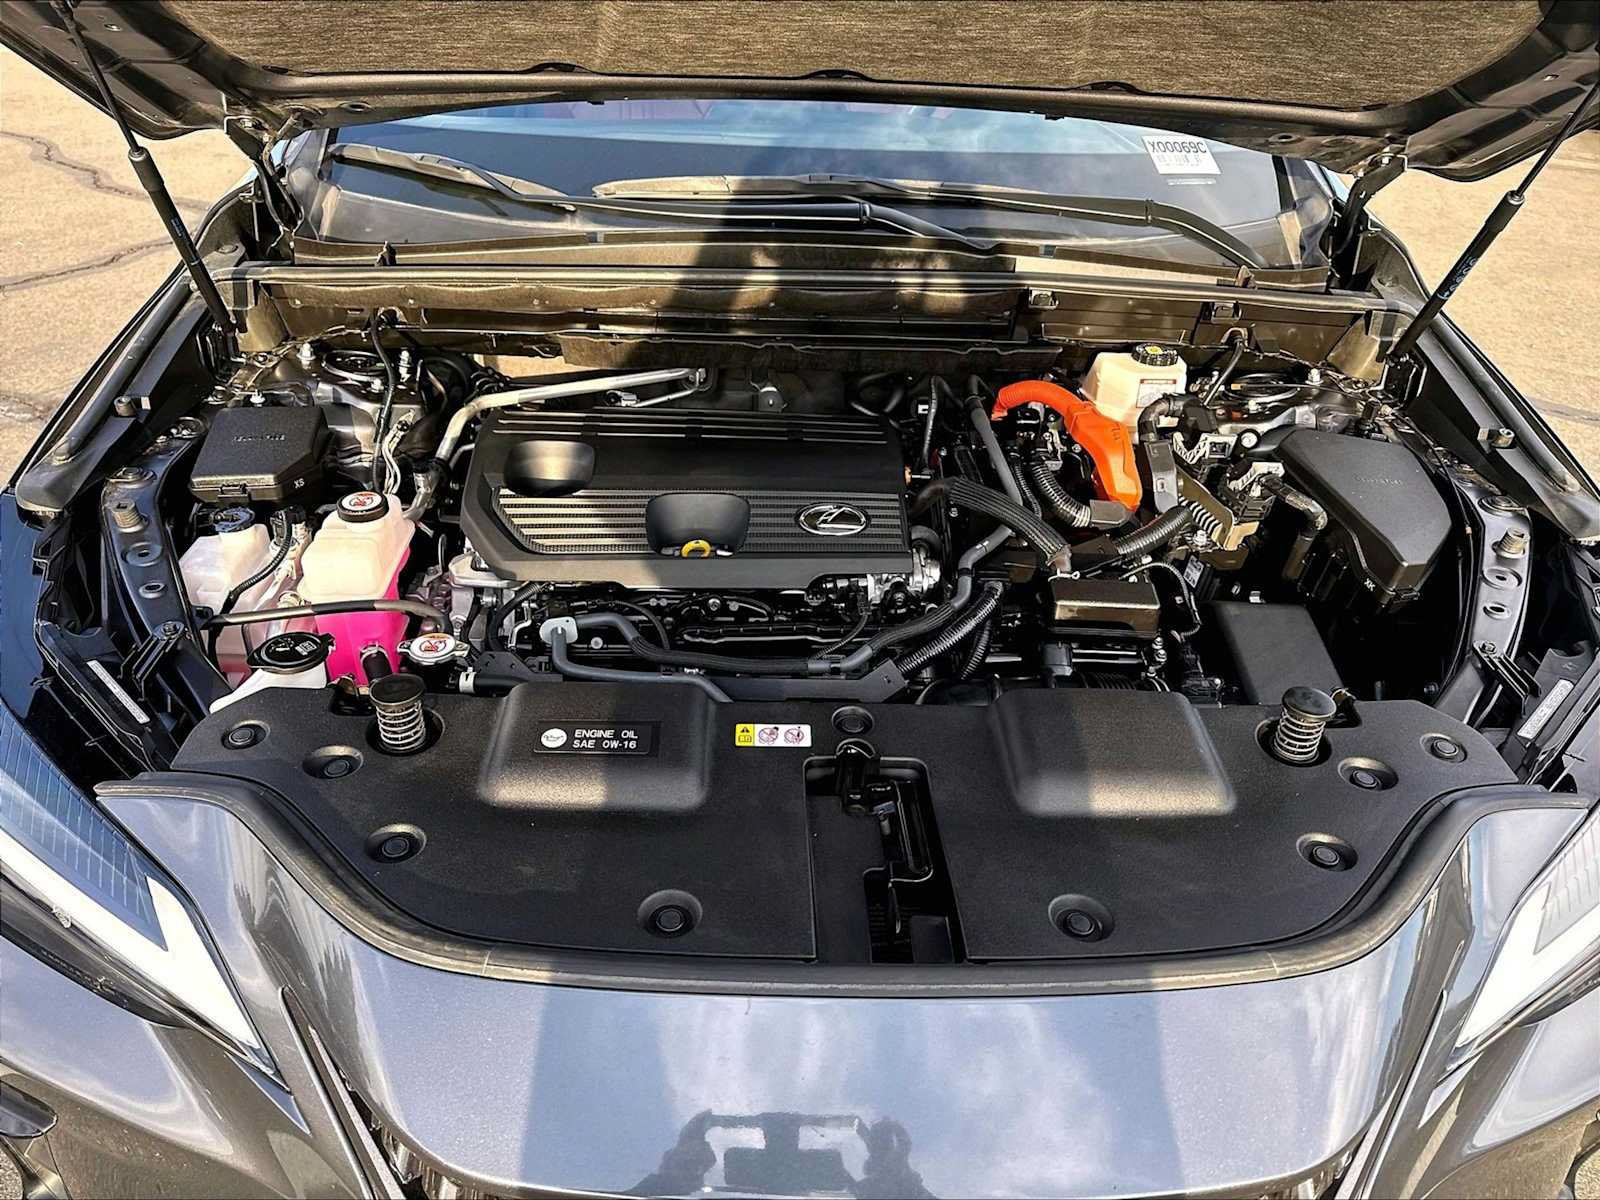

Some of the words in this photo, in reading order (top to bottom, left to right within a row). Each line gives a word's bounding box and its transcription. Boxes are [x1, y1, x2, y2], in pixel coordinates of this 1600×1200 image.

[1147, 141, 1207, 153] X00069C
[574, 729, 615, 738] ENGINE
[621, 730, 638, 738] OIL
[573, 740, 596, 748] SAE
